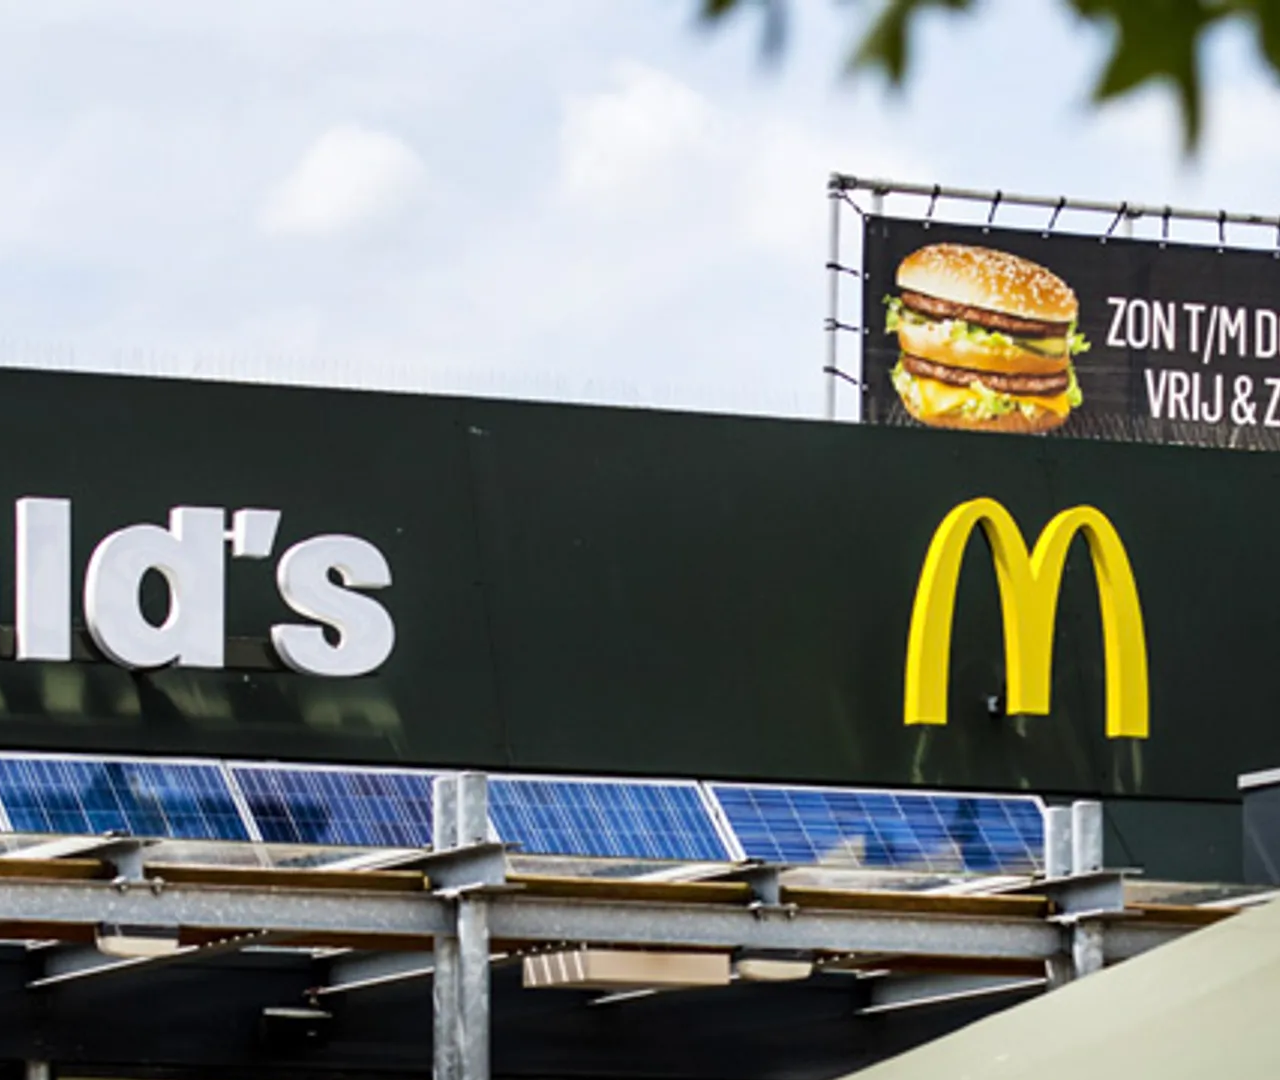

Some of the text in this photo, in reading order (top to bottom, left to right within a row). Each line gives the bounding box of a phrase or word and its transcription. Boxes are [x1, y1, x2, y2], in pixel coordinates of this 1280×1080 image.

[1105, 297, 1176, 351] ZON
[1182, 303, 1247, 364] T/M
[1144, 368, 1223, 422] VRIJ
[1230, 374, 1258, 426] &
